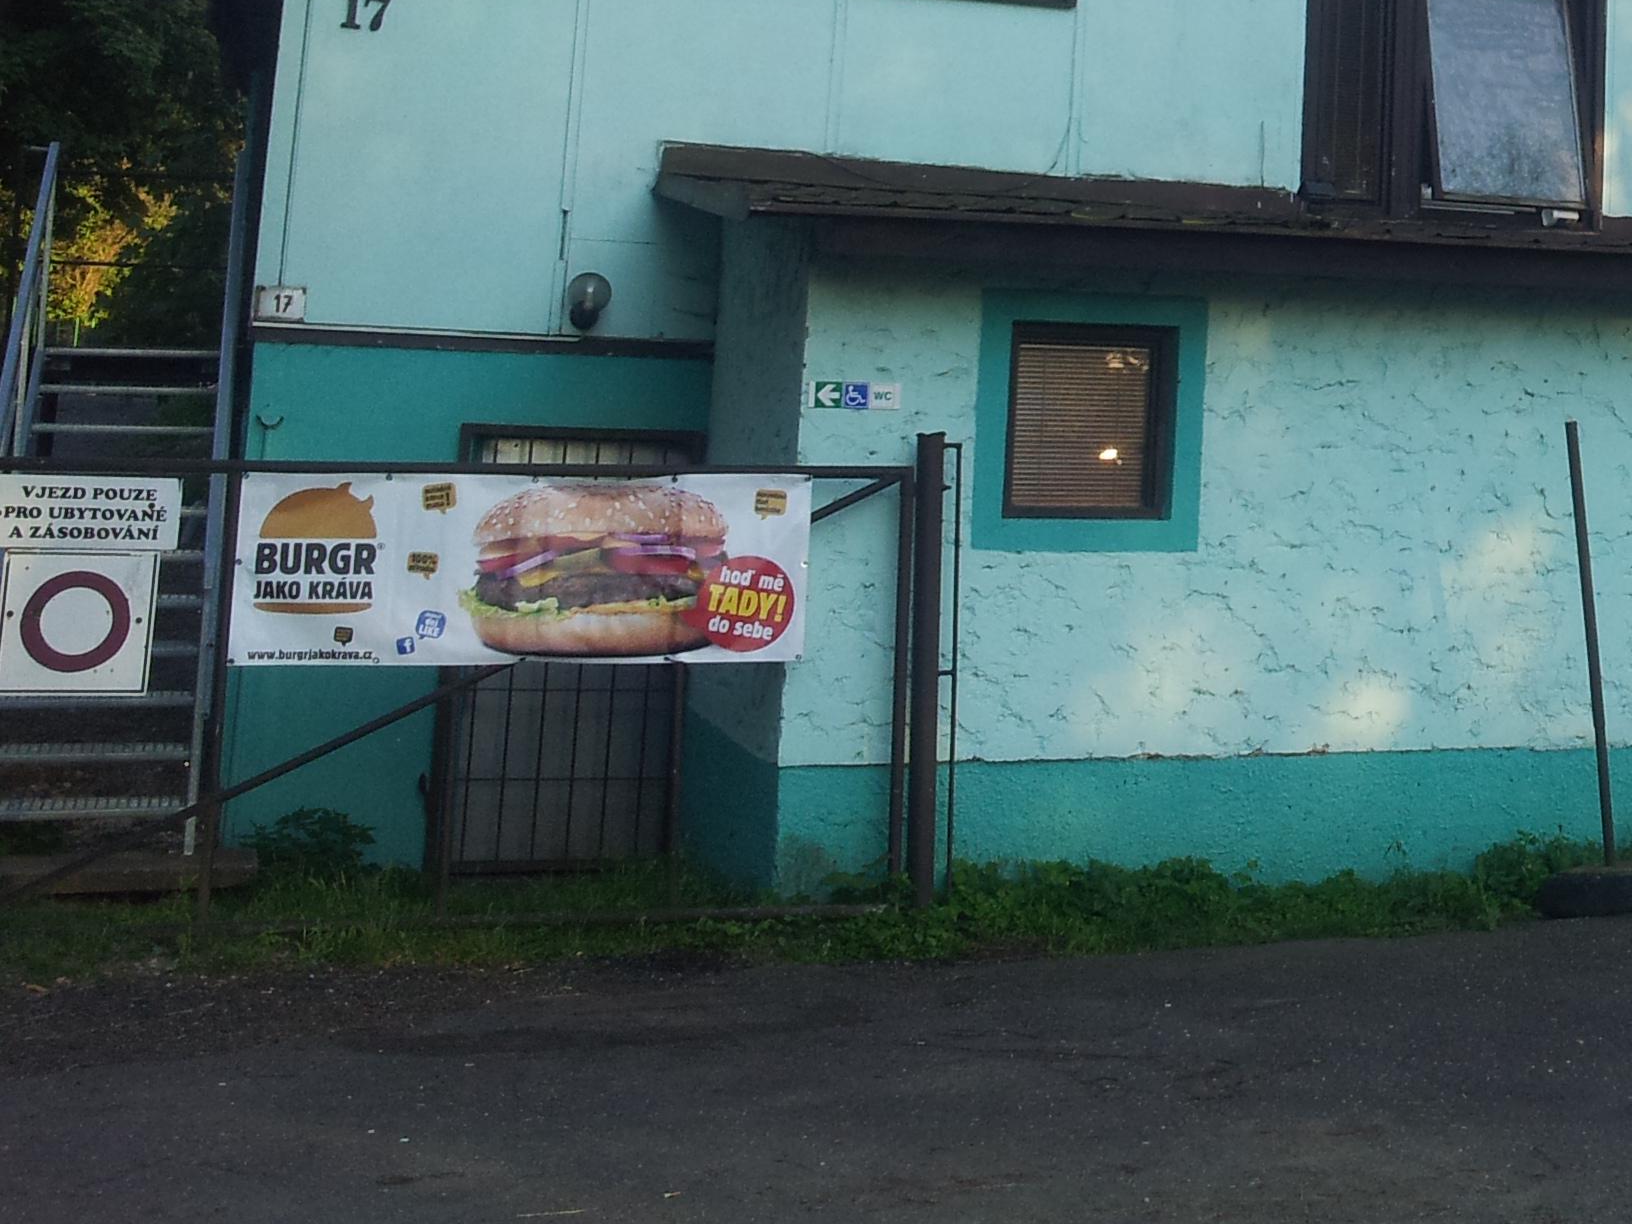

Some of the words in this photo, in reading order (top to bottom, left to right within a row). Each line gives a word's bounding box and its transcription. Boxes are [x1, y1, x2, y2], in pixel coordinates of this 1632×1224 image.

[274, 294, 293, 313] 17
[873, 391, 893, 401] WC
[22, 485, 87, 500] VJEZD
[93, 487, 157, 502] POUZE
[4, 506, 42, 519] PRO
[49, 506, 168, 522] UBYTOVANÉ
[9, 526, 23, 539] A
[29, 523, 160, 540] ZÁSOBOVÁNÍ
[254, 542, 377, 575] BURGR
[719, 565, 756, 586] hoď
[758, 574, 785, 591] mě
[253, 580, 301, 600] JAKO
[307, 577, 373, 600] KRÁVA
[707, 583, 787, 623] TADY!
[707, 614, 730, 633] do
[732, 620, 774, 641] sebe
[247, 648, 373, 662] www.burgrjakokrava.cz
